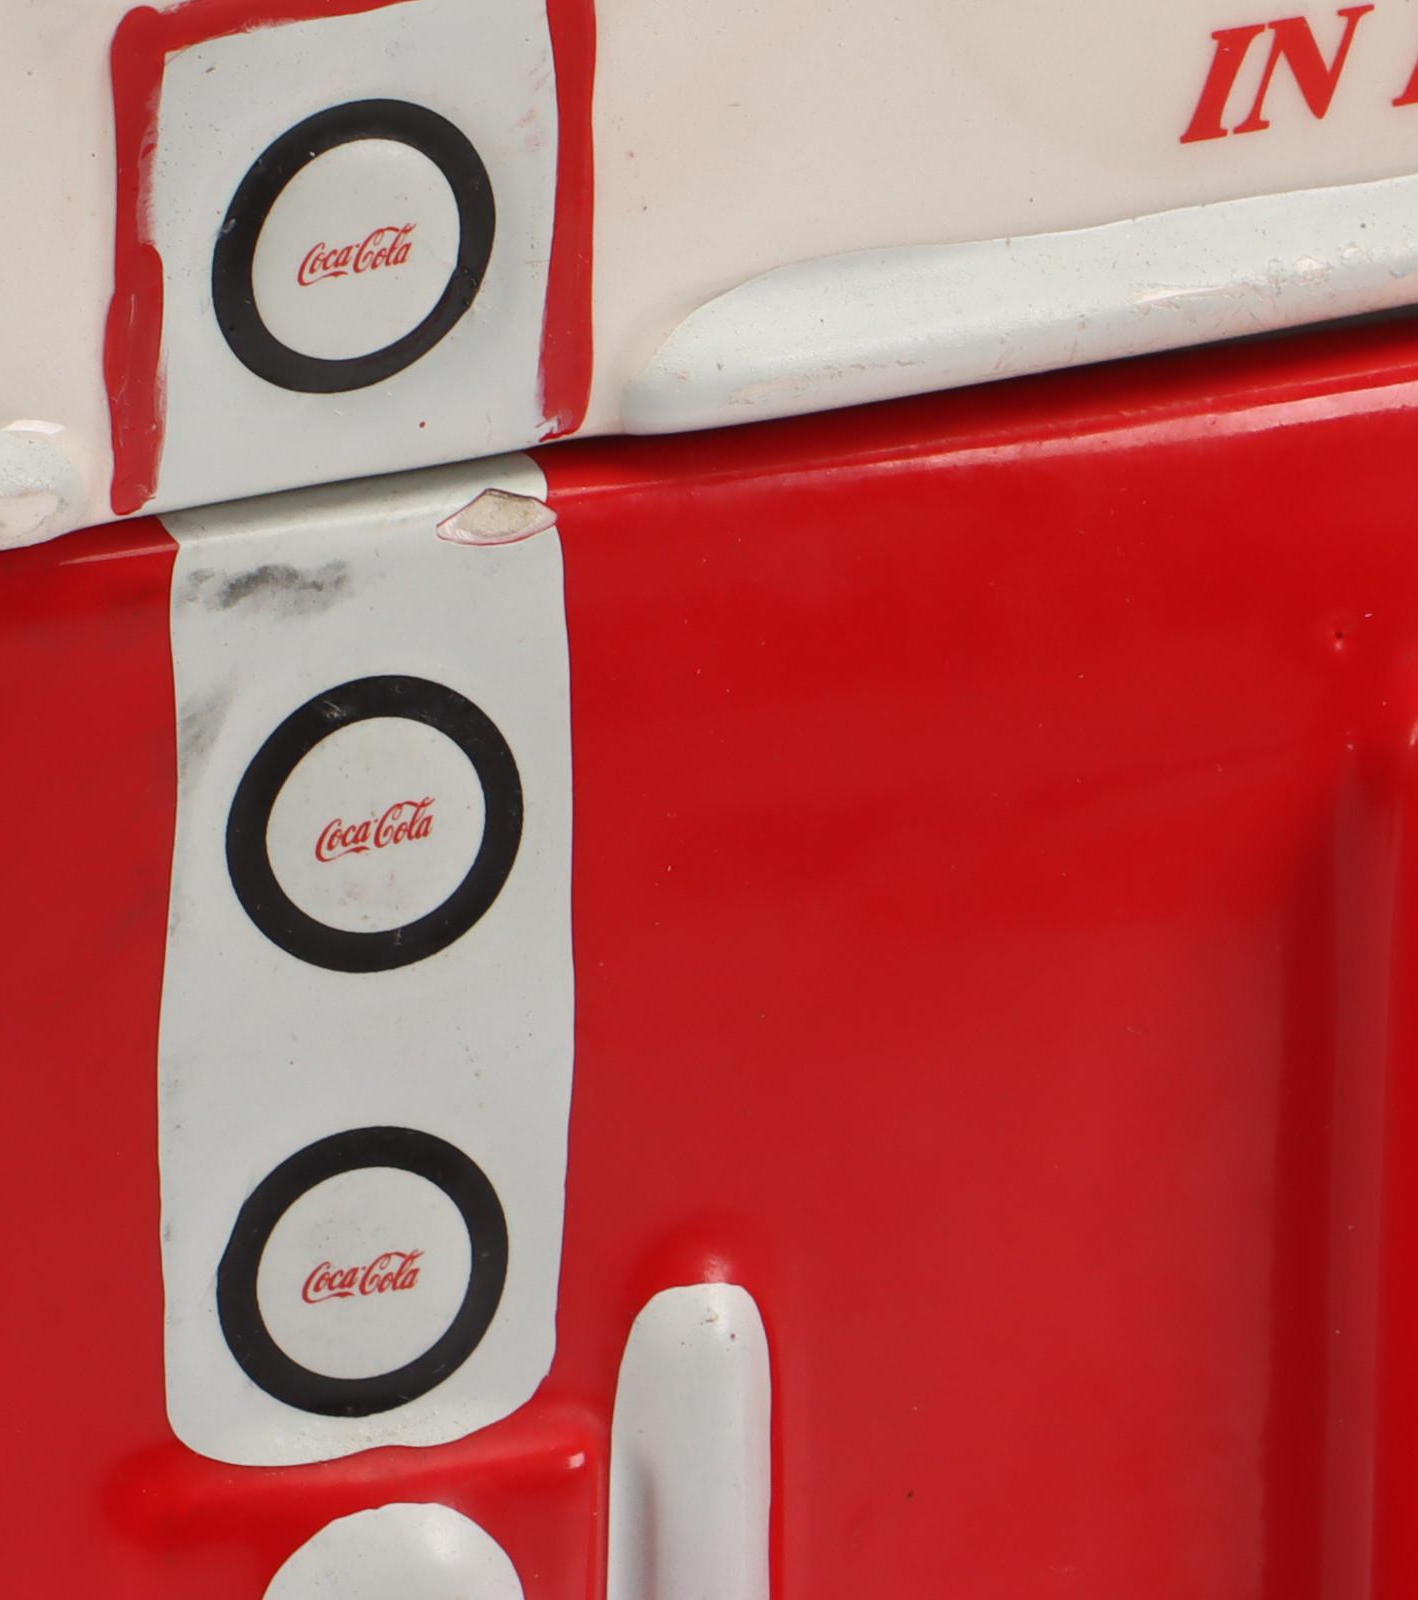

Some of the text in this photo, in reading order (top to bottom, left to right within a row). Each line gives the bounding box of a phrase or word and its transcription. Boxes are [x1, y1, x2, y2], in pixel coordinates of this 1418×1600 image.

[1178, 2, 1376, 145] IN
[297, 222, 417, 287] Coca-Cola
[315, 796, 437, 863] Coca-Cola
[301, 1248, 425, 1305] Coca-Cola
